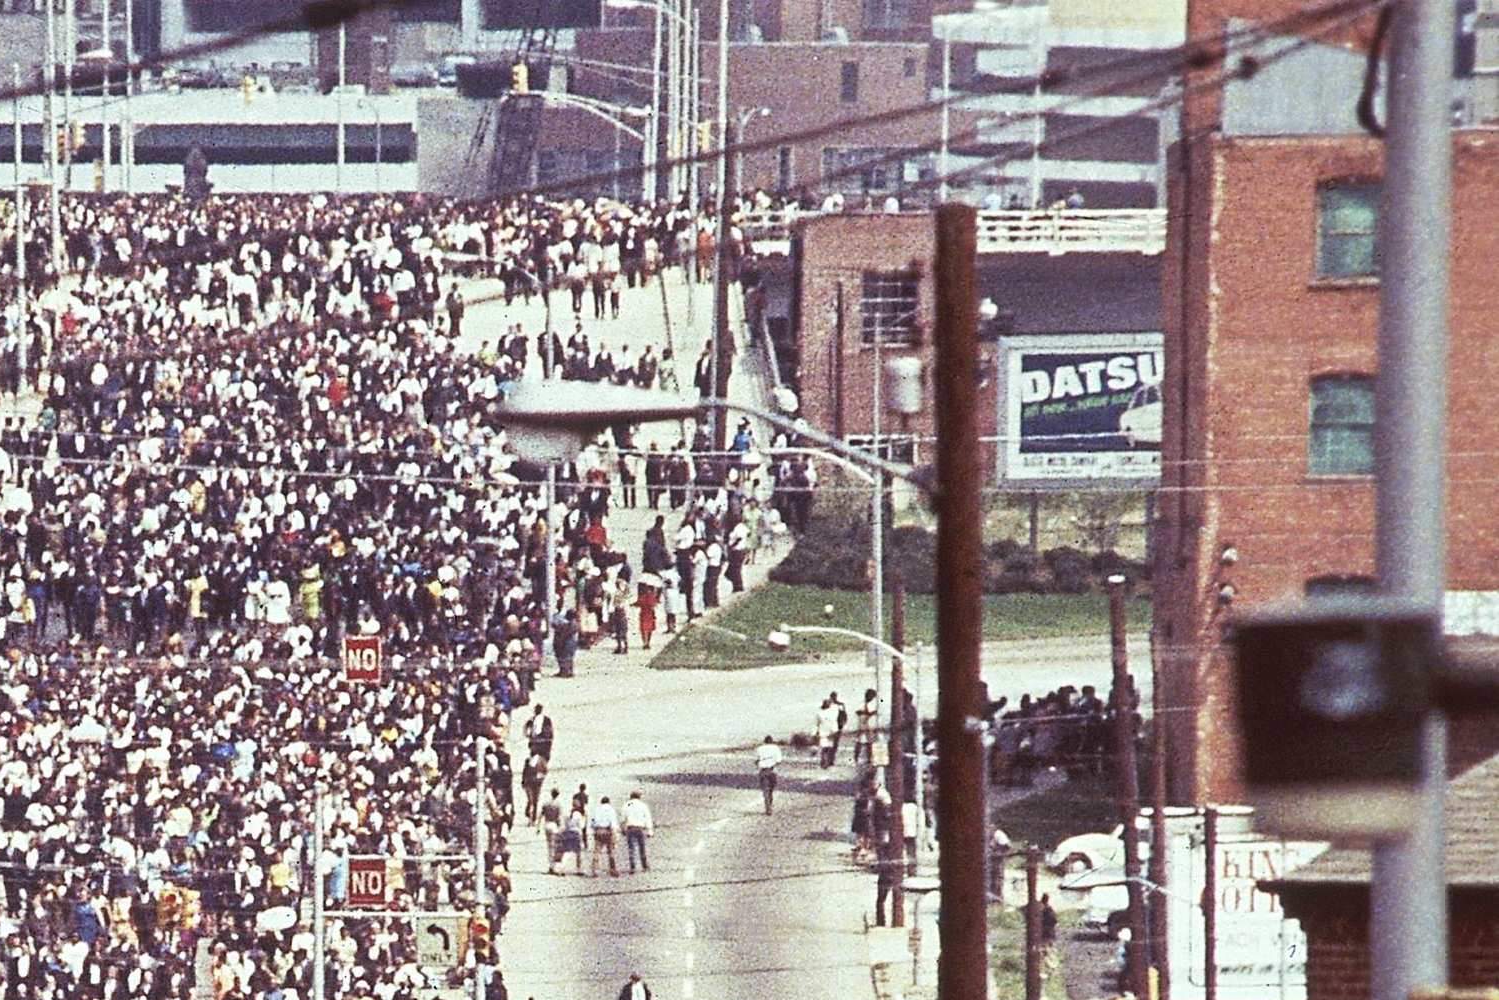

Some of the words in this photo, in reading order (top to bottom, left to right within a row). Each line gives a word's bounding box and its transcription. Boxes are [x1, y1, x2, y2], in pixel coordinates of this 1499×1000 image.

[348, 648, 376, 671] NO
[352, 871, 382, 895] NO
[421, 952, 453, 963] ONLY
